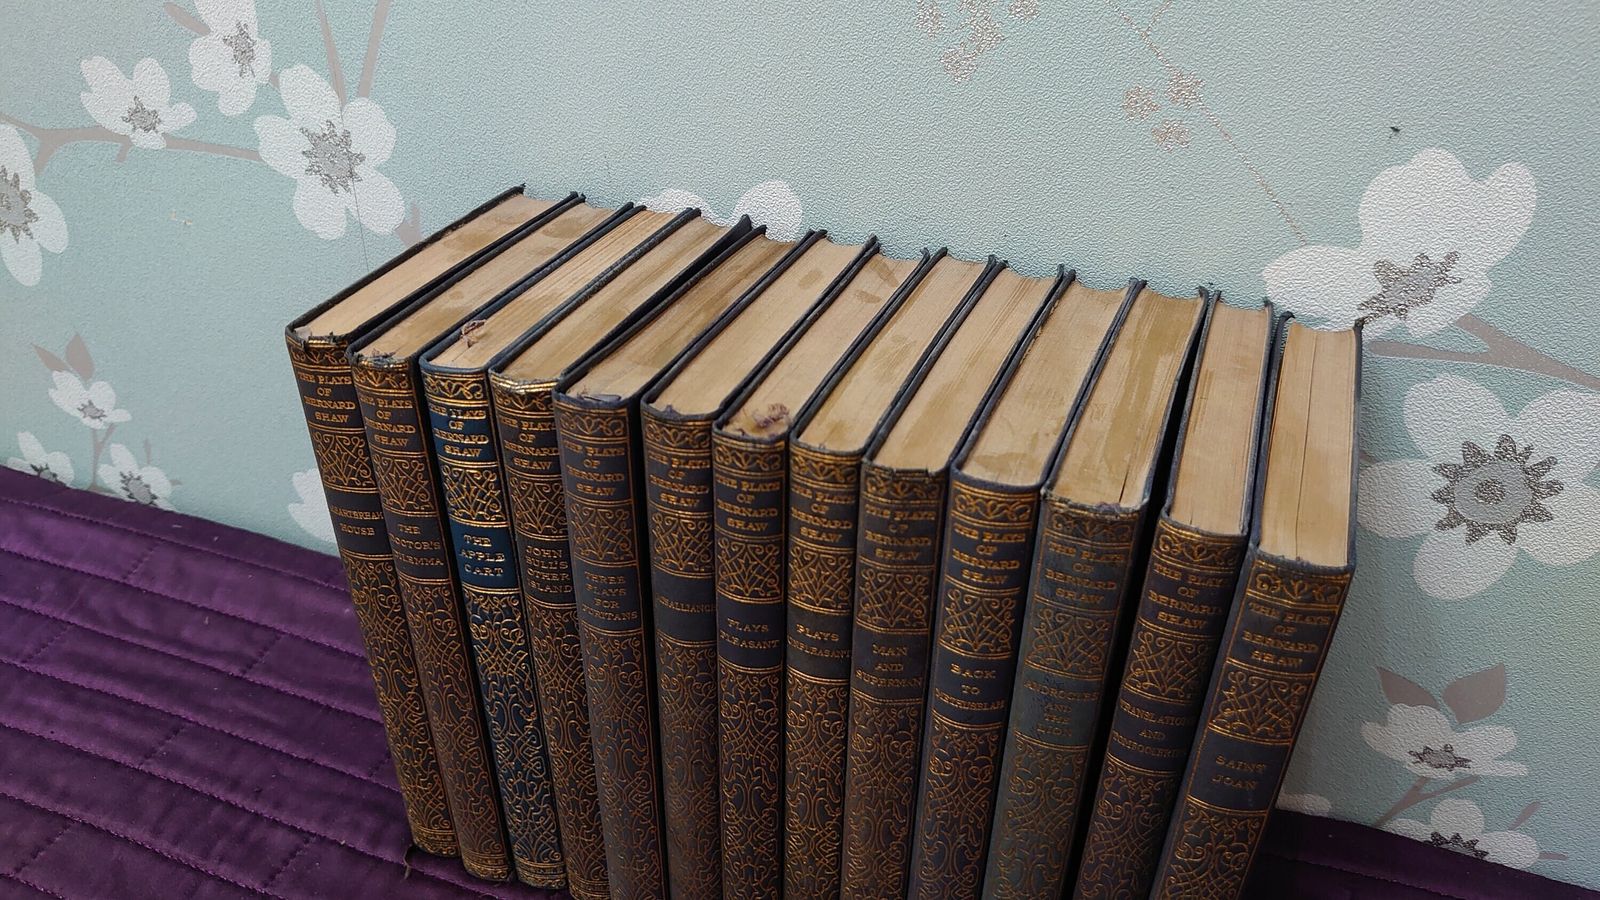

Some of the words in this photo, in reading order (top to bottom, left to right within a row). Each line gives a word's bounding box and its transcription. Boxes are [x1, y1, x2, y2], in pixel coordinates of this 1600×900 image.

[318, 375, 352, 385] PLAYS
[317, 387, 332, 397] OF
[304, 396, 356, 410] BERNARD
[379, 398, 413, 409] PLAYS
[315, 412, 349, 423] SHAW
[376, 411, 391, 420] OF
[449, 408, 486, 420] PLAYS
[364, 417, 416, 434] BERNARD
[448, 421, 465, 430] OF
[374, 434, 409, 447] SHAW
[432, 428, 489, 444] BERNARD
[519, 433, 536, 442] OF
[443, 445, 483, 458] SHAW
[587, 446, 625, 456] PLAYS
[513, 457, 551, 470] SHAW
[583, 459, 600, 469] OF
[671, 456, 710, 469] PLAYS
[567, 465, 624, 481] BERNARD
[668, 470, 685, 479] OF
[576, 483, 616, 496] SHAW
[650, 474, 709, 494] BERNARD
[741, 479, 780, 491] PLAYS
[660, 493, 699, 506] SHAW
[737, 493, 755, 503] OF
[815, 491, 855, 504] PLAYS
[717, 499, 777, 517] BERNARD
[811, 504, 829, 514] OF
[791, 507, 852, 529] BERNARD
[894, 511, 936, 521] PLAYS
[340, 523, 375, 536] HOUSE
[398, 524, 421, 535] THE
[727, 518, 768, 531] SHAW
[888, 524, 909, 533] OF
[463, 534, 492, 547] THE
[800, 527, 842, 542] SHAW
[865, 530, 932, 546] BERNARD
[983, 532, 1025, 542] PLAYS
[459, 549, 505, 562] APPLE
[526, 545, 562, 558] JOHN
[875, 549, 920, 560] SHAW
[976, 545, 997, 556] OF
[1081, 551, 1125, 563] PLAYS
[526, 557, 569, 570] BULL'S
[952, 549, 1020, 570] BERNARD
[464, 565, 504, 577] CART
[526, 568, 570, 581] OTHER
[1072, 563, 1095, 574] OF
[584, 571, 626, 585] THREE
[961, 569, 1008, 584] SHAW
[1045, 568, 1117, 590] BERNARD
[527, 579, 572, 593] ISLAND
[585, 583, 627, 596] PLAYS
[1177, 586, 1199, 598] OF
[1056, 588, 1104, 604] SHAW
[594, 599, 620, 609] FOR
[727, 617, 769, 632] PLAYS
[1157, 611, 1207, 629] SHAW
[1284, 614, 1330, 625] PLAYS
[796, 624, 839, 641] PLAYS
[1274, 625, 1297, 636] OF
[720, 629, 780, 649] PLEASANT
[1241, 630, 1319, 654] BERNARD
[872, 643, 907, 656] MAN
[1251, 650, 1303, 668] SHAW
[874, 663, 904, 672] AND
[950, 663, 997, 679] BACK
[855, 669, 922, 687] SUPERMAN
[961, 684, 980, 695] TO
[1139, 729, 1166, 741] AND
[1215, 754, 1265, 773] SAINT
[1211, 774, 1258, 789] JOAN
